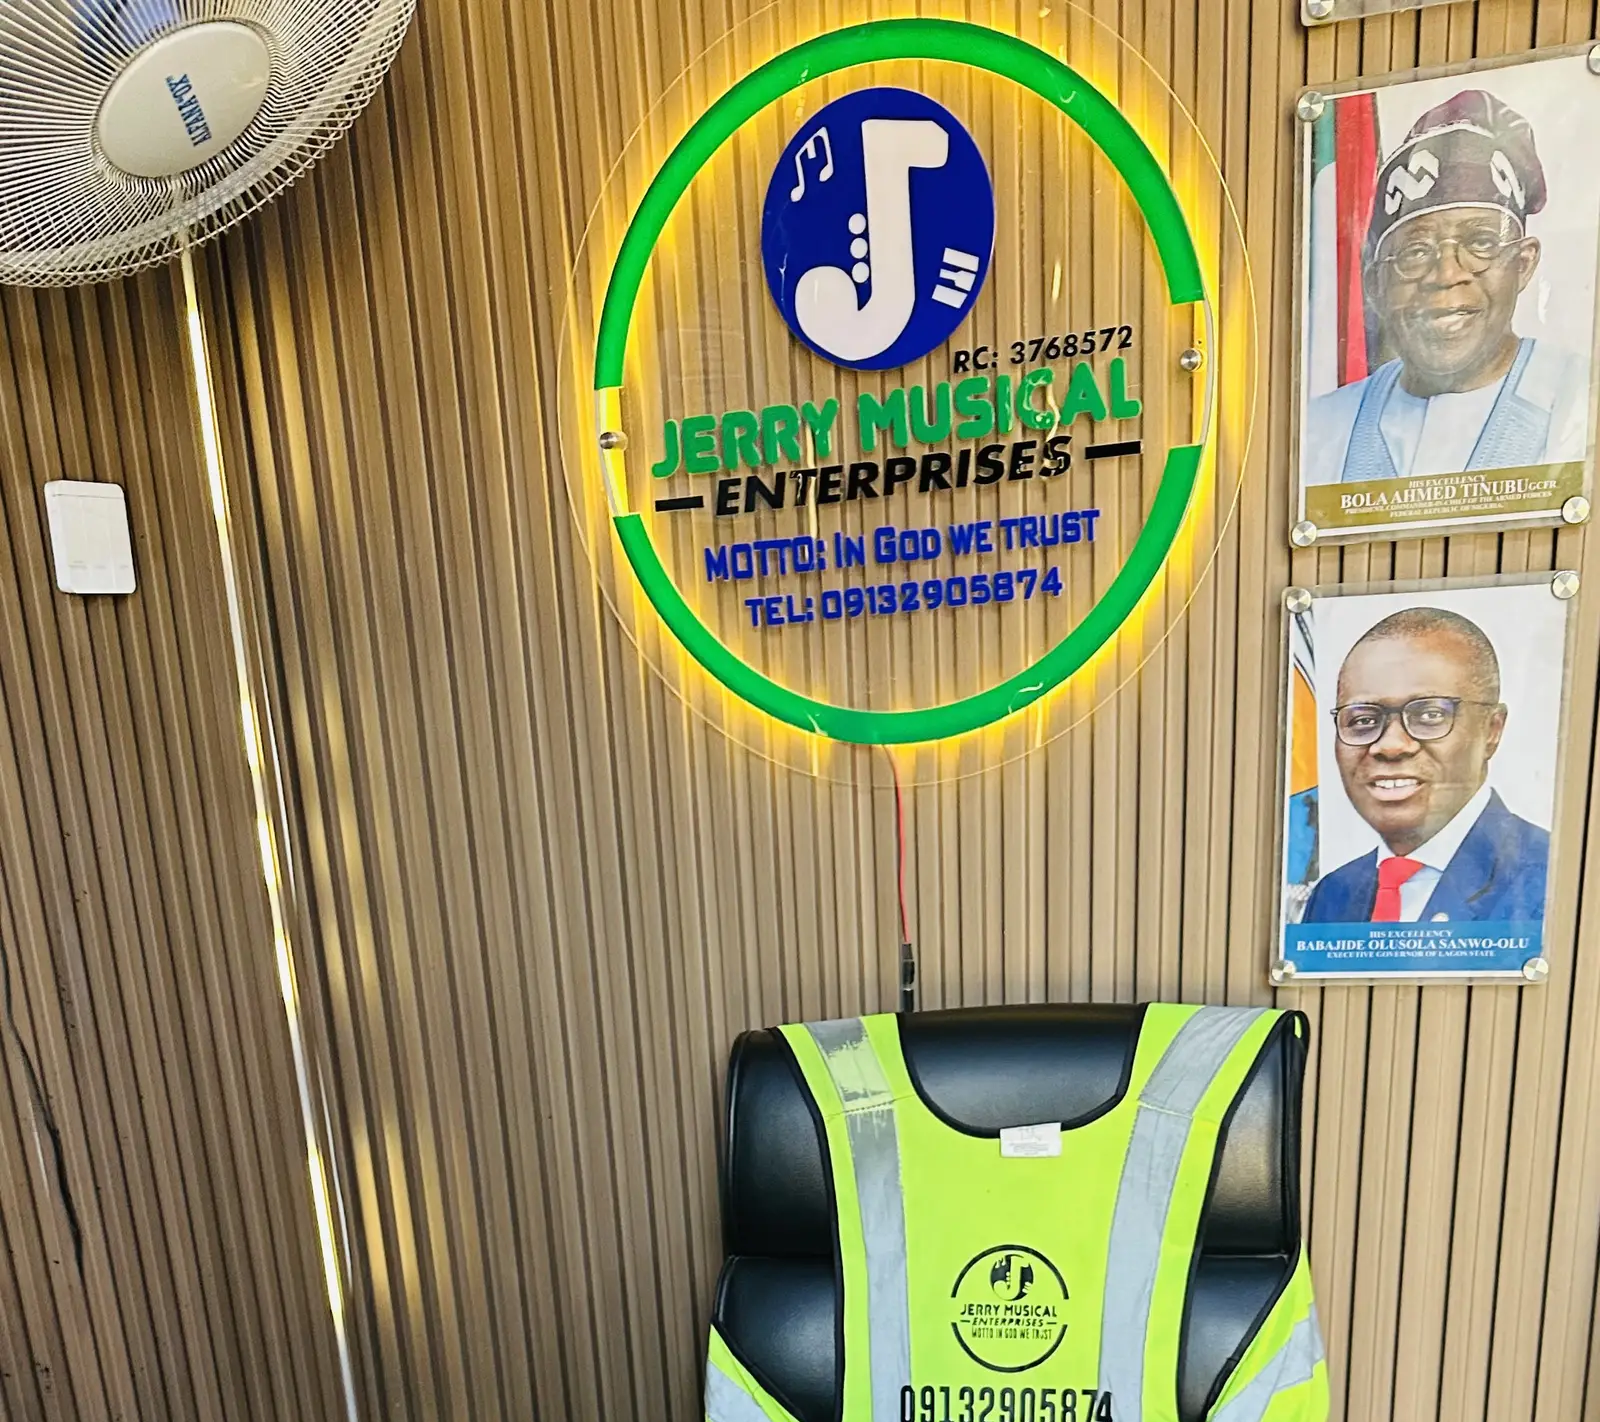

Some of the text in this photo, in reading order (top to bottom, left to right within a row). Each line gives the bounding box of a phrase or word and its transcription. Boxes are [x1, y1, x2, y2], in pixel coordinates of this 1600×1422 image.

[953, 325, 1134, 374] RC: 3768572
[651, 357, 1142, 479] JERRY MUSICAL
[715, 435, 1073, 516] ENTERPRISES
[1426, 474, 1487, 486] EXCELLENCY
[1341, 492, 1388, 509] BOLA
[1390, 484, 1457, 504] AHMED
[704, 536, 826, 583] MOTTO:
[947, 520, 993, 556] WE
[999, 509, 1101, 549] TRUST
[744, 566, 1064, 628] TEL: 09132905874
[1388, 929, 1453, 938] EXCELLENCY
[1296, 937, 1530, 951] BABAJIDE OLUSOLA SANWO-OLU
[960, 1303, 1057, 1317] JERRY MUSICAL
[972, 1317, 1044, 1327] ENTERPRISES
[972, 1327, 1052, 1340] MOTTO IN GOD WE TRUST
